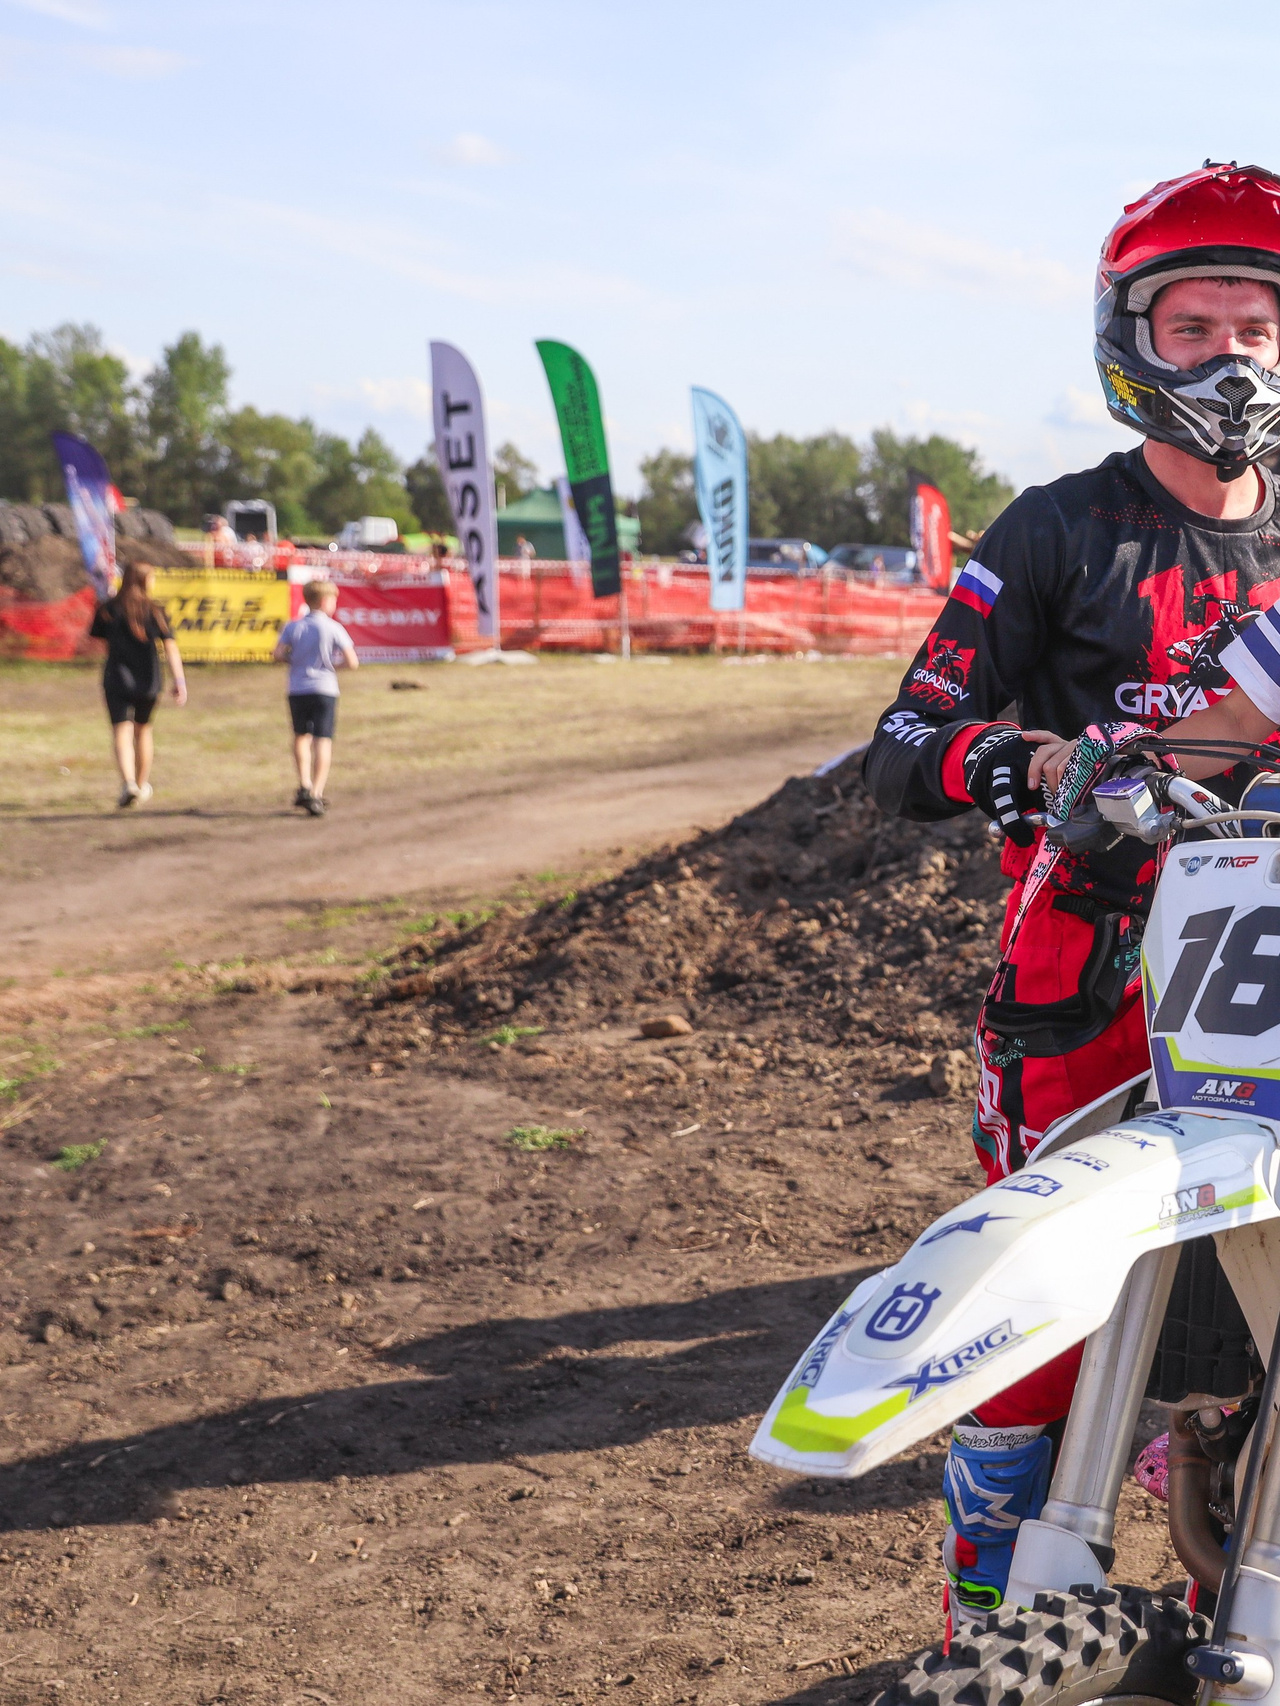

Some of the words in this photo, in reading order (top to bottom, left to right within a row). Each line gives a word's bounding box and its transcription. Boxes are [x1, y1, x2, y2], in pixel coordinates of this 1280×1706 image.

[913, 668, 970, 701] GRYAZNOV
[1115, 682, 1233, 718] GRYA
[1214, 856, 1259, 871] MXGP
[1191, 1095, 1256, 1107] MOTOGRAPHICS
[1196, 1079, 1257, 1098] ANG
[1159, 1183, 1216, 1220] ANG
[1159, 1205, 1225, 1230] MOTOGRAPHICS
[884, 1327, 1008, 1400] XTRIG
